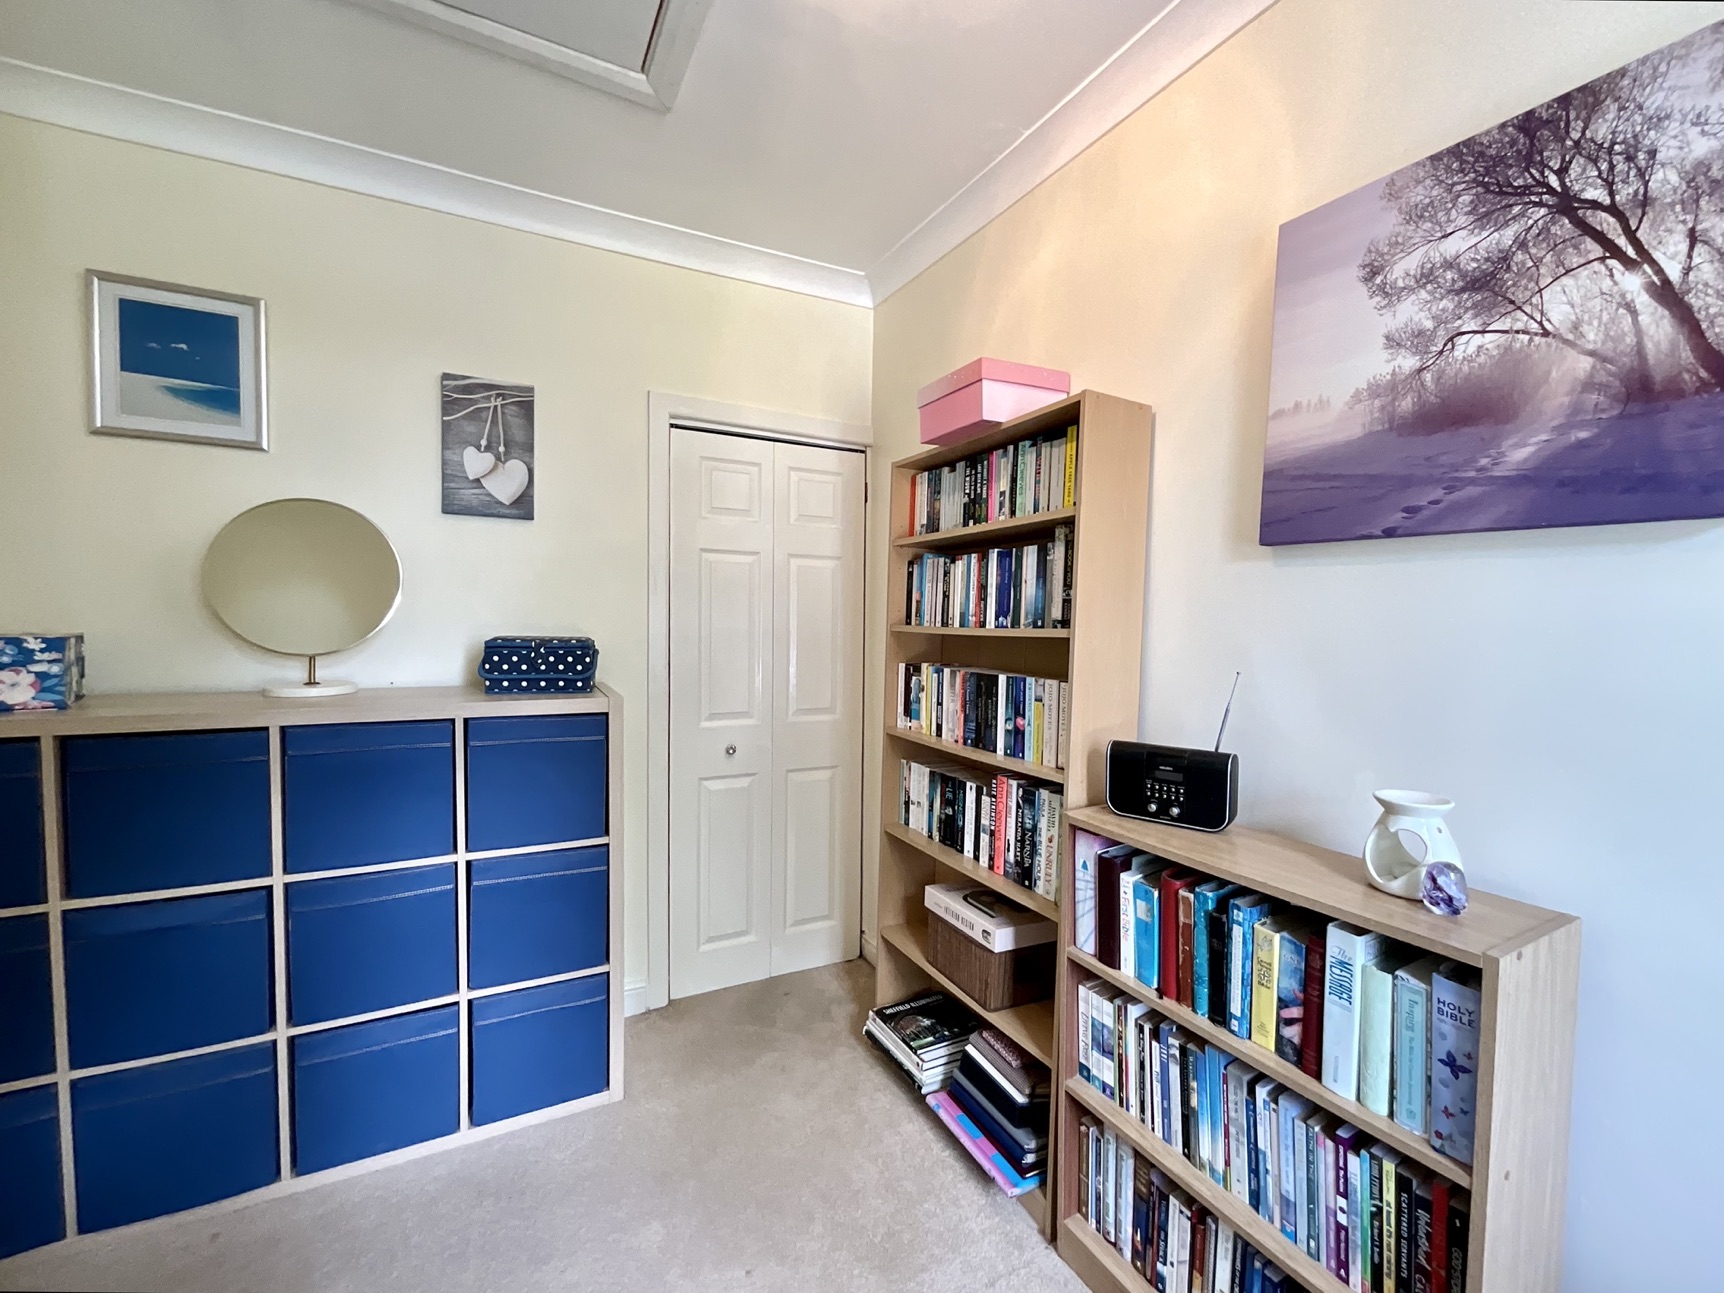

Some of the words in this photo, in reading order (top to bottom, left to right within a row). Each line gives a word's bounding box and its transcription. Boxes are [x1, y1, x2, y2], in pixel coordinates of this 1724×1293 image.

[1018, 461, 1026, 496] Cleeves
[997, 777, 1006, 800] Ann
[996, 800, 1005, 841] Cleeves
[1023, 830, 1032, 868] NARNIA
[1044, 845, 1054, 886] UNRULY
[1121, 896, 1130, 918] First
[1121, 918, 1130, 942] Bible
[1331, 945, 1353, 961] The
[1329, 955, 1354, 1005] MESSAGE
[883, 1003, 911, 1015] SHEFFIELD
[1405, 998, 1419, 1032] Inspire
[1437, 997, 1475, 1018] HOLY
[1437, 1006, 1476, 1029] BIBLE
[1309, 1152, 1314, 1161] IN
[1415, 1209, 1433, 1271] Unleashed
[1400, 1238, 1408, 1278] SERVANTS
